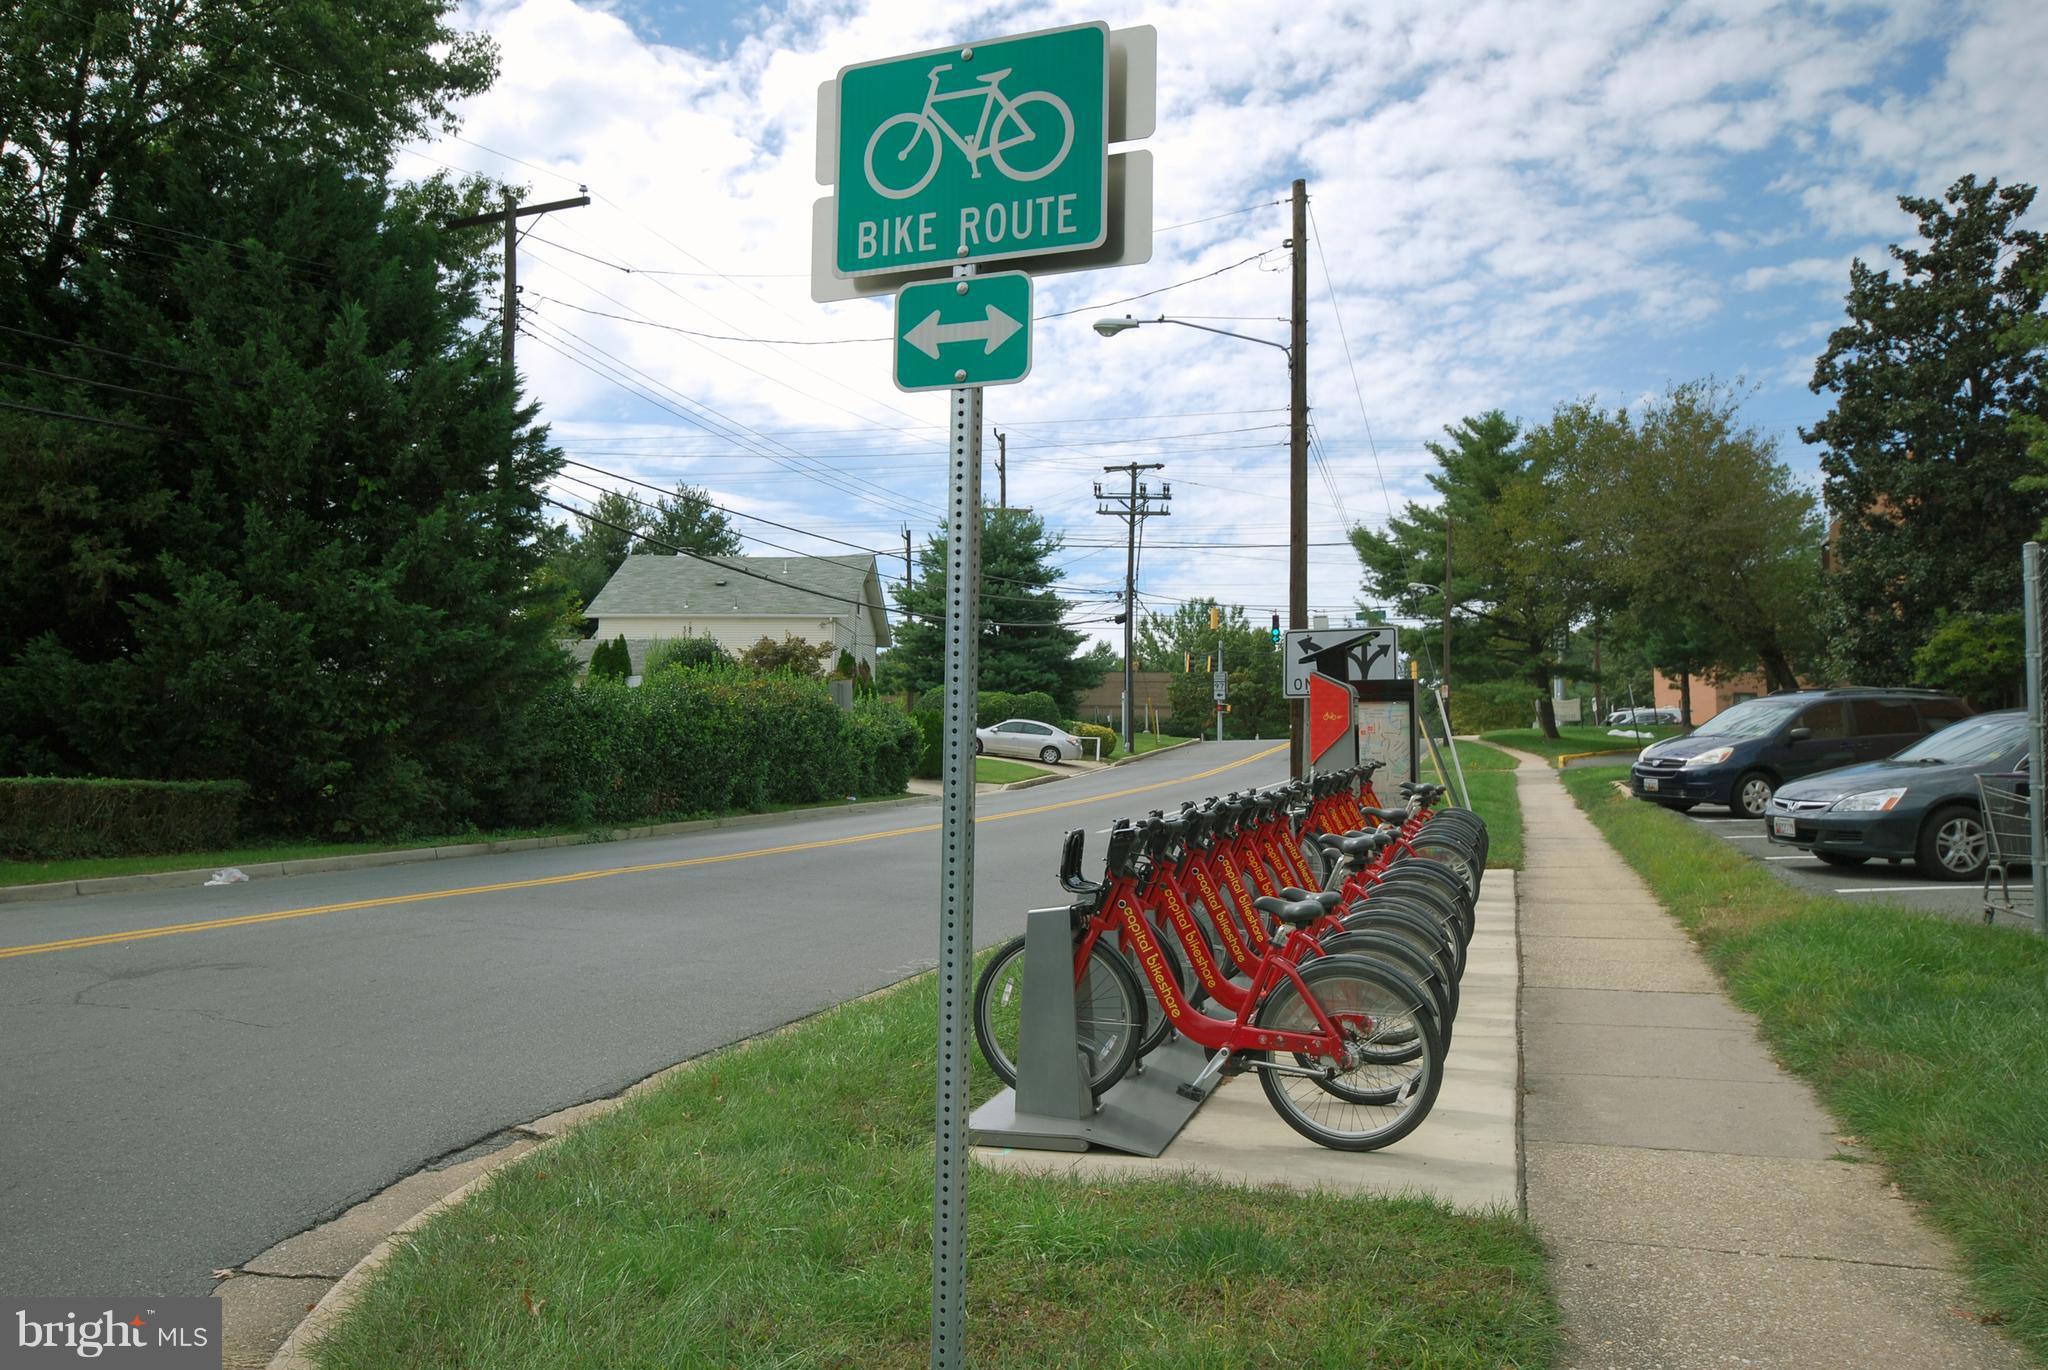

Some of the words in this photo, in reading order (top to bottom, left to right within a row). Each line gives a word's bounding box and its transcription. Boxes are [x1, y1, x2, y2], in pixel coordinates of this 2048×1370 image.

[857, 212, 938, 260] BIKE
[959, 193, 1078, 246] ROUTE
[1246, 850, 1268, 882] capital
[1264, 842, 1286, 871] capital
[1282, 832, 1301, 860] capital
[1164, 889, 1192, 930] capital
[1185, 930, 1216, 988] bikeshare
[1196, 873, 1222, 911] capital
[1216, 910, 1245, 963] bikeshare
[1222, 859, 1244, 894] capital
[1238, 893, 1264, 943] bikeshare
[1123, 906, 1154, 953] capital
[1146, 953, 1181, 1018] bikeshare
